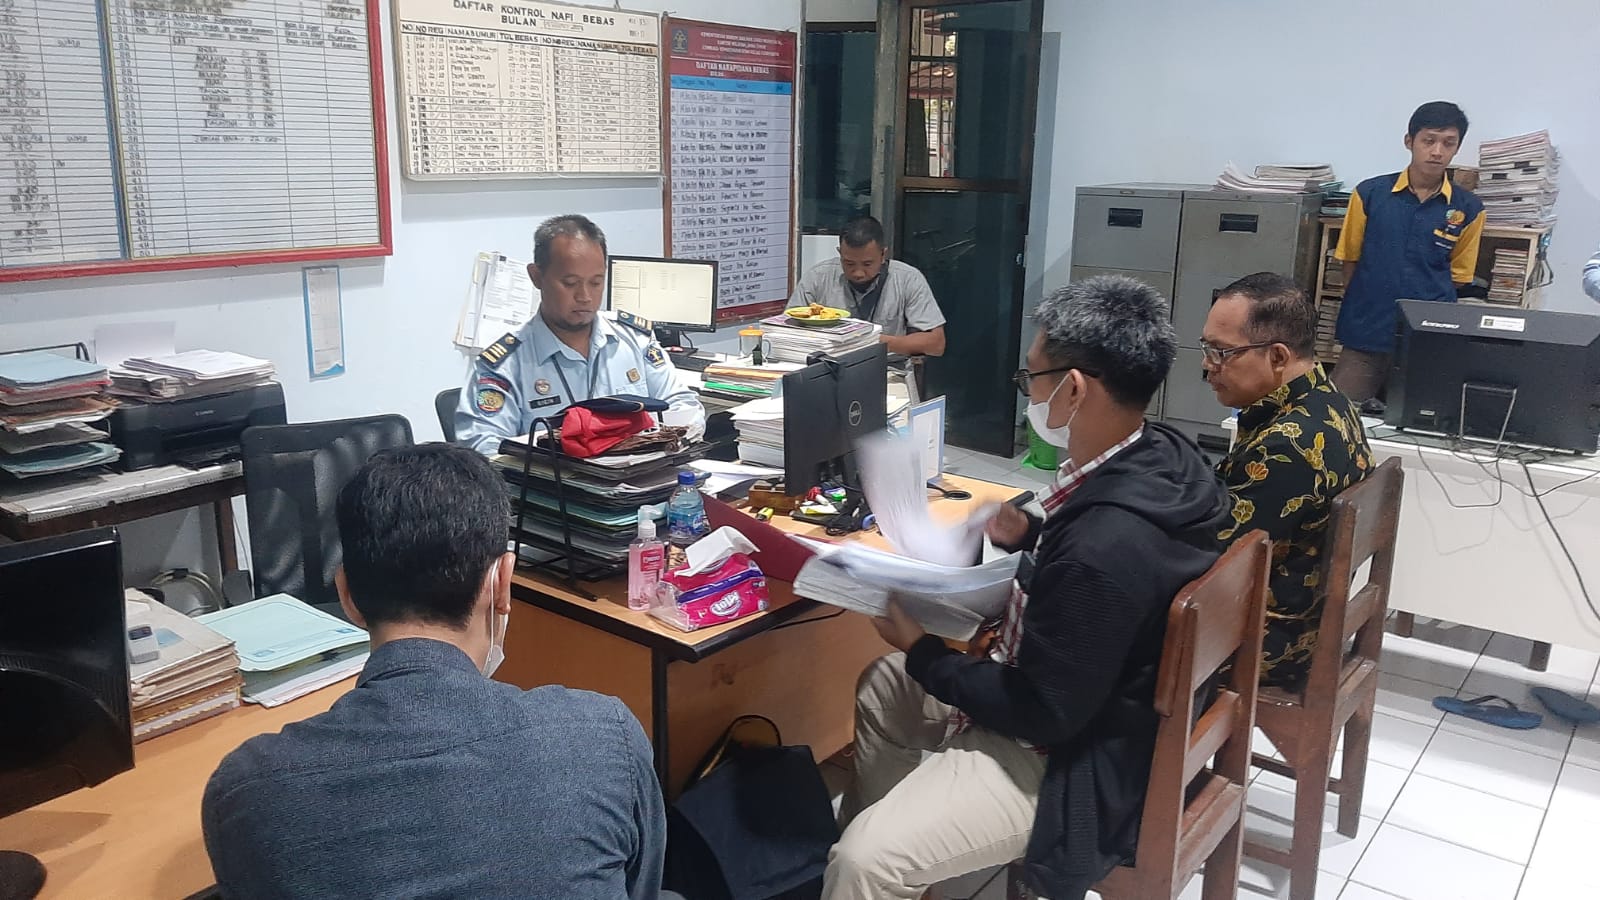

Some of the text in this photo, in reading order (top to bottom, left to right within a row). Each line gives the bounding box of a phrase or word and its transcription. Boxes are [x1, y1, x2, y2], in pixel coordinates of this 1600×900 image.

[453, 0, 494, 12] DAFTAR
[501, 5, 546, 18] KONTROL
[582, 14, 616, 26] BEBAS
[501, 15, 537, 27] BULAN
